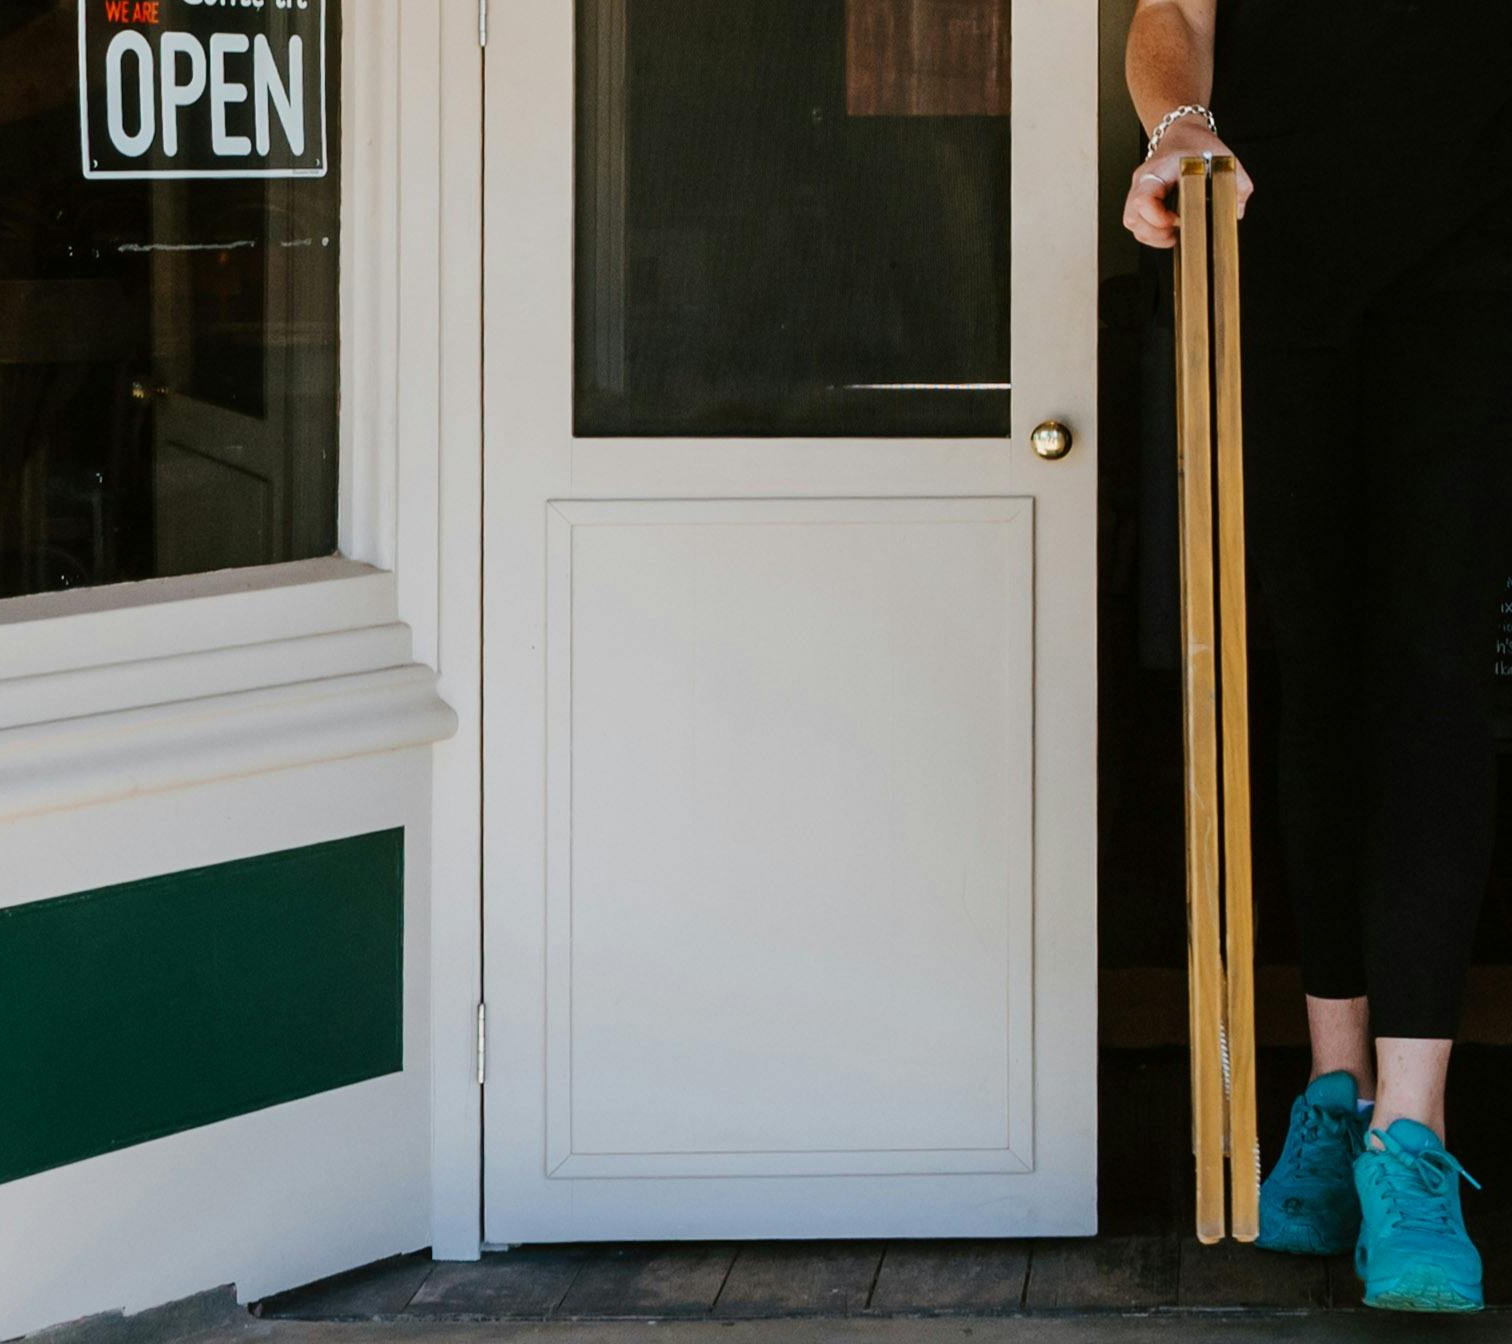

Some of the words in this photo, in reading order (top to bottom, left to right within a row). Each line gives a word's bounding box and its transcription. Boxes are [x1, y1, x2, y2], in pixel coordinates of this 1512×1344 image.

[105, 0, 130, 24] WE
[131, 0, 160, 25] ARE
[105, 29, 305, 158] OPEN
